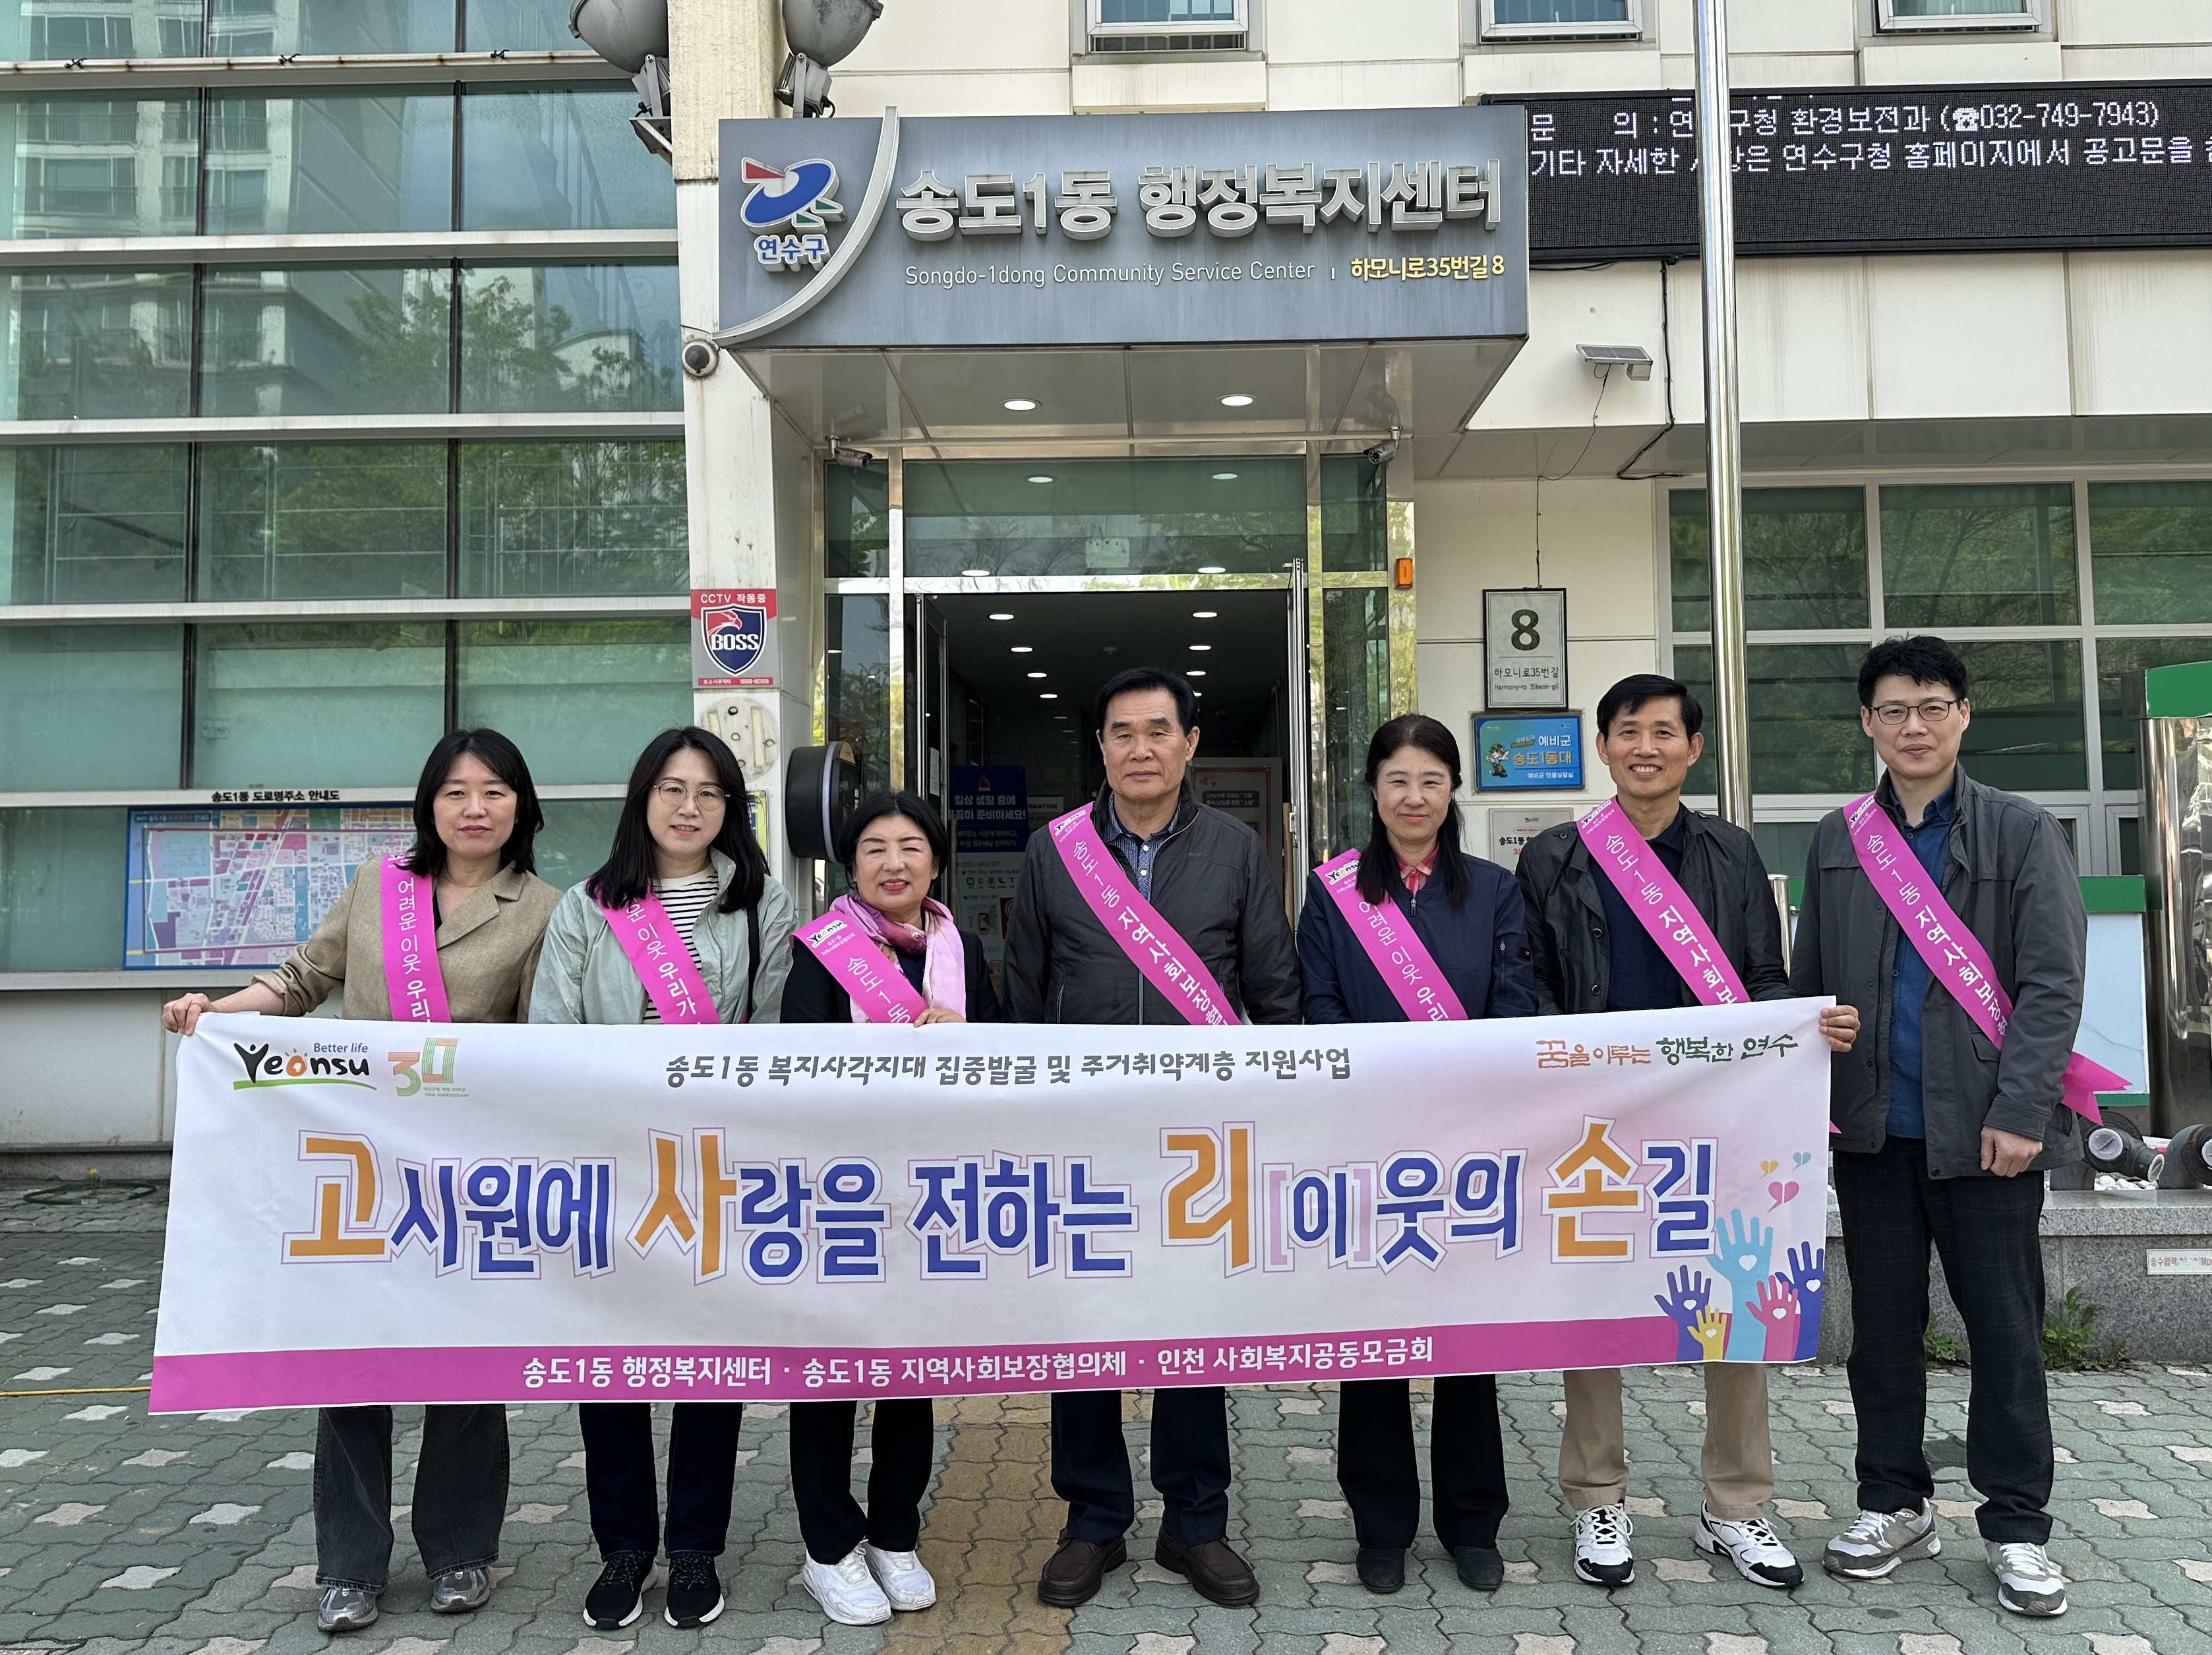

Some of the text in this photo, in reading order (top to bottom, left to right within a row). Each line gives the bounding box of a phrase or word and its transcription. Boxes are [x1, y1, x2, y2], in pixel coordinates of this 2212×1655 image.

[1530, 113, 1555, 141] 문
[1613, 111, 1637, 138] 의
[1669, 109, 1777, 138] 연구청
[1791, 105, 1930, 135] 환경보전과
[1530, 149, 1586, 177] 기타
[1596, 147, 1679, 175] 자세한
[1783, 141, 1891, 171] 연수구청
[1904, 137, 2070, 169] 홈페이지에서
[2083, 136, 2194, 166] 공고문을
[895, 160, 1501, 239] 송도1동 행정복지센터
[757, 237, 825, 262] 연수구
[905, 255, 1505, 289] Songdo-1dong Community Service Center 하모니로35번길 8
[700, 593, 767, 604] CCTV 작동중
[711, 634, 760, 651] BOSS
[1510, 609, 1541, 651] 8
[1493, 666, 1559, 678] 하모니로35번길
[1512, 750, 1572, 766] 송도1동대
[1538, 735, 1572, 747] 예비군
[212, 790, 340, 802] 송도1동 도로명주소 안내도
[954, 795, 973, 806] 일상
[1499, 836, 1525, 845] 송도1동
[1605, 833, 1663, 905] 송도1동
[1866, 833, 1921, 905] 송도1동
[398, 877, 417, 931] 어려운
[1073, 840, 1228, 1025] 송도1동 지역사회보장협
[401, 934, 421, 975] 이웃
[638, 922, 668, 961] 이웃
[658, 961, 697, 1017] 우리가
[406, 979, 431, 1022] 우리
[847, 957, 911, 1024] 송도1동
[1391, 946, 1423, 986] 이웃
[1416, 986, 1450, 1021] 우리
[233, 1042, 371, 1084] Yeonsu
[313, 1041, 369, 1054] Better life
[1536, 1033, 1799, 1069] 꿈을 이루는 행복한 연수
[665, 1048, 1350, 1089] 송도1동 복지사각지대 집중발굴 및 주거취약계층 지원사업
[285, 1134, 612, 1275] 고시원에
[631, 1132, 887, 1279] 사랑을
[911, 1157, 1134, 1275] 전하는
[1546, 1122, 1714, 1258] 손길
[522, 1335, 1433, 1389] 송도1동 행정복지센터 송도1동 지역사회보장협의체 인천 사회복지공동모금회
